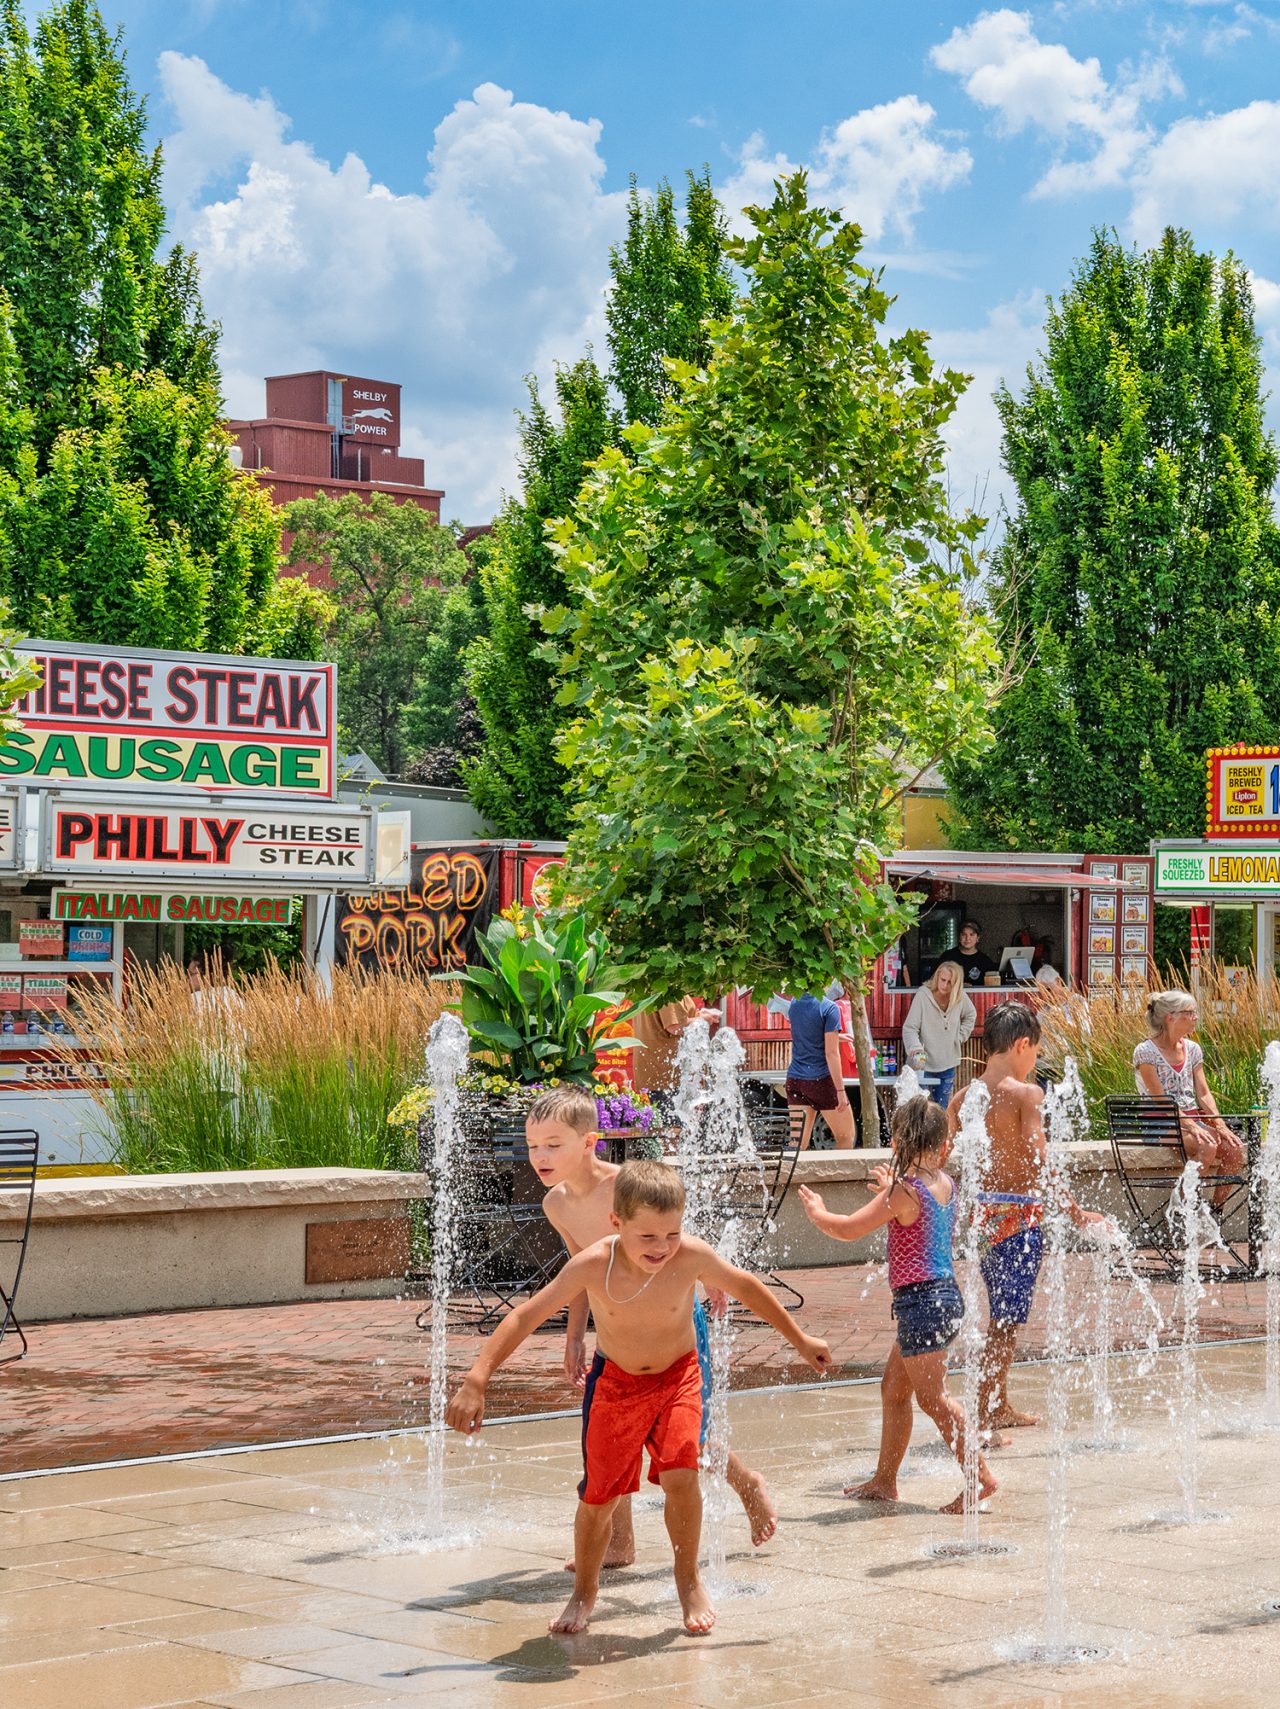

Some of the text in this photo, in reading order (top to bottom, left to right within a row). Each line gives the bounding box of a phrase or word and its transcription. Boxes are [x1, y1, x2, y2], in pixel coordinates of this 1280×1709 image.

[353, 390, 387, 402] SHELBY
[354, 424, 387, 436] POWER
[0, 655, 322, 731] HEESE STEAK
[0, 732, 321, 788] SAUSAGE
[1229, 767, 1262, 777] FRESHLY
[1229, 778, 1262, 787] BREWED
[1234, 792, 1256, 802] Lipton
[1227, 805, 1263, 815] ICED TEA
[56, 811, 246, 864] PHILLY
[247, 823, 361, 843] CHEESE
[260, 848, 356, 867] STEAK
[1168, 858, 1203, 869] FRESHLY
[1162, 870, 1205, 881] SQUEEZED
[57, 893, 290, 924] ITALIAN SAUSAGE
[79, 930, 102, 939] COLD
[341, 912, 467, 968] PORK
